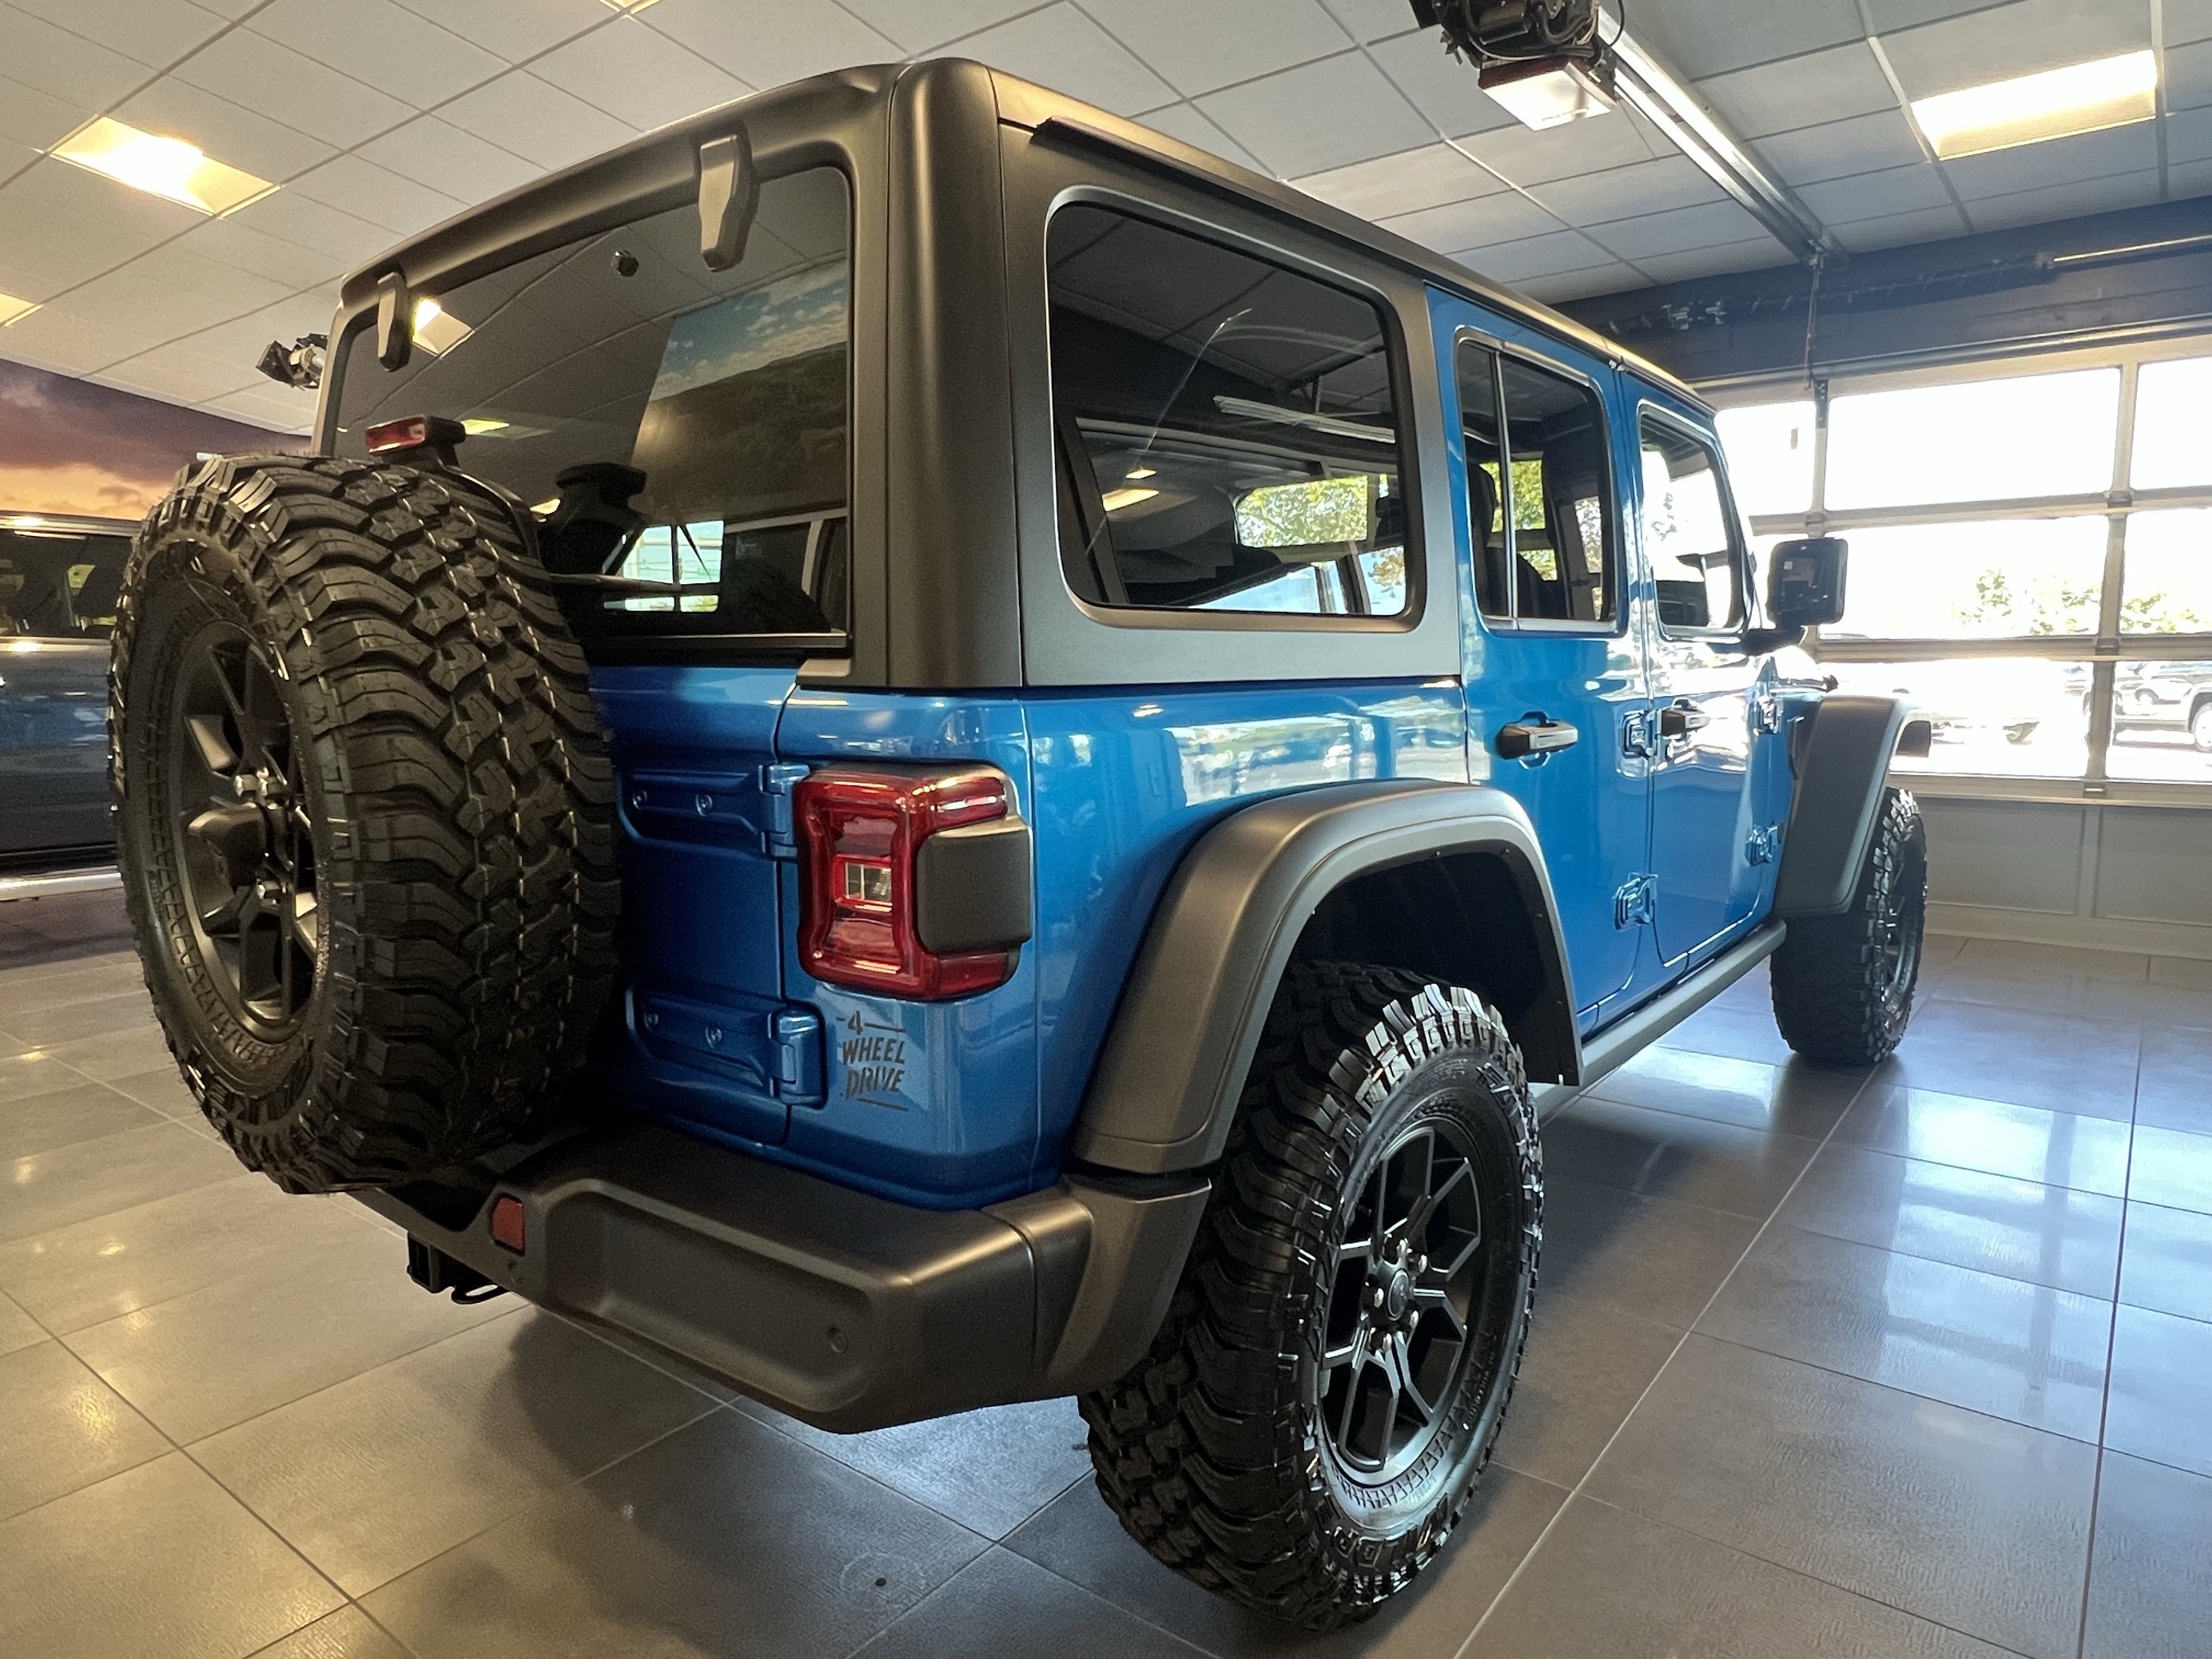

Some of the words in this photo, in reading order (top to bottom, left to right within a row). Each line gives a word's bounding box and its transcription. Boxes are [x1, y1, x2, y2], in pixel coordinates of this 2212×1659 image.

[848, 1010, 863, 1035] 4
[842, 1036, 905, 1065] WHEEL
[845, 1066, 905, 1098] DRIVE
